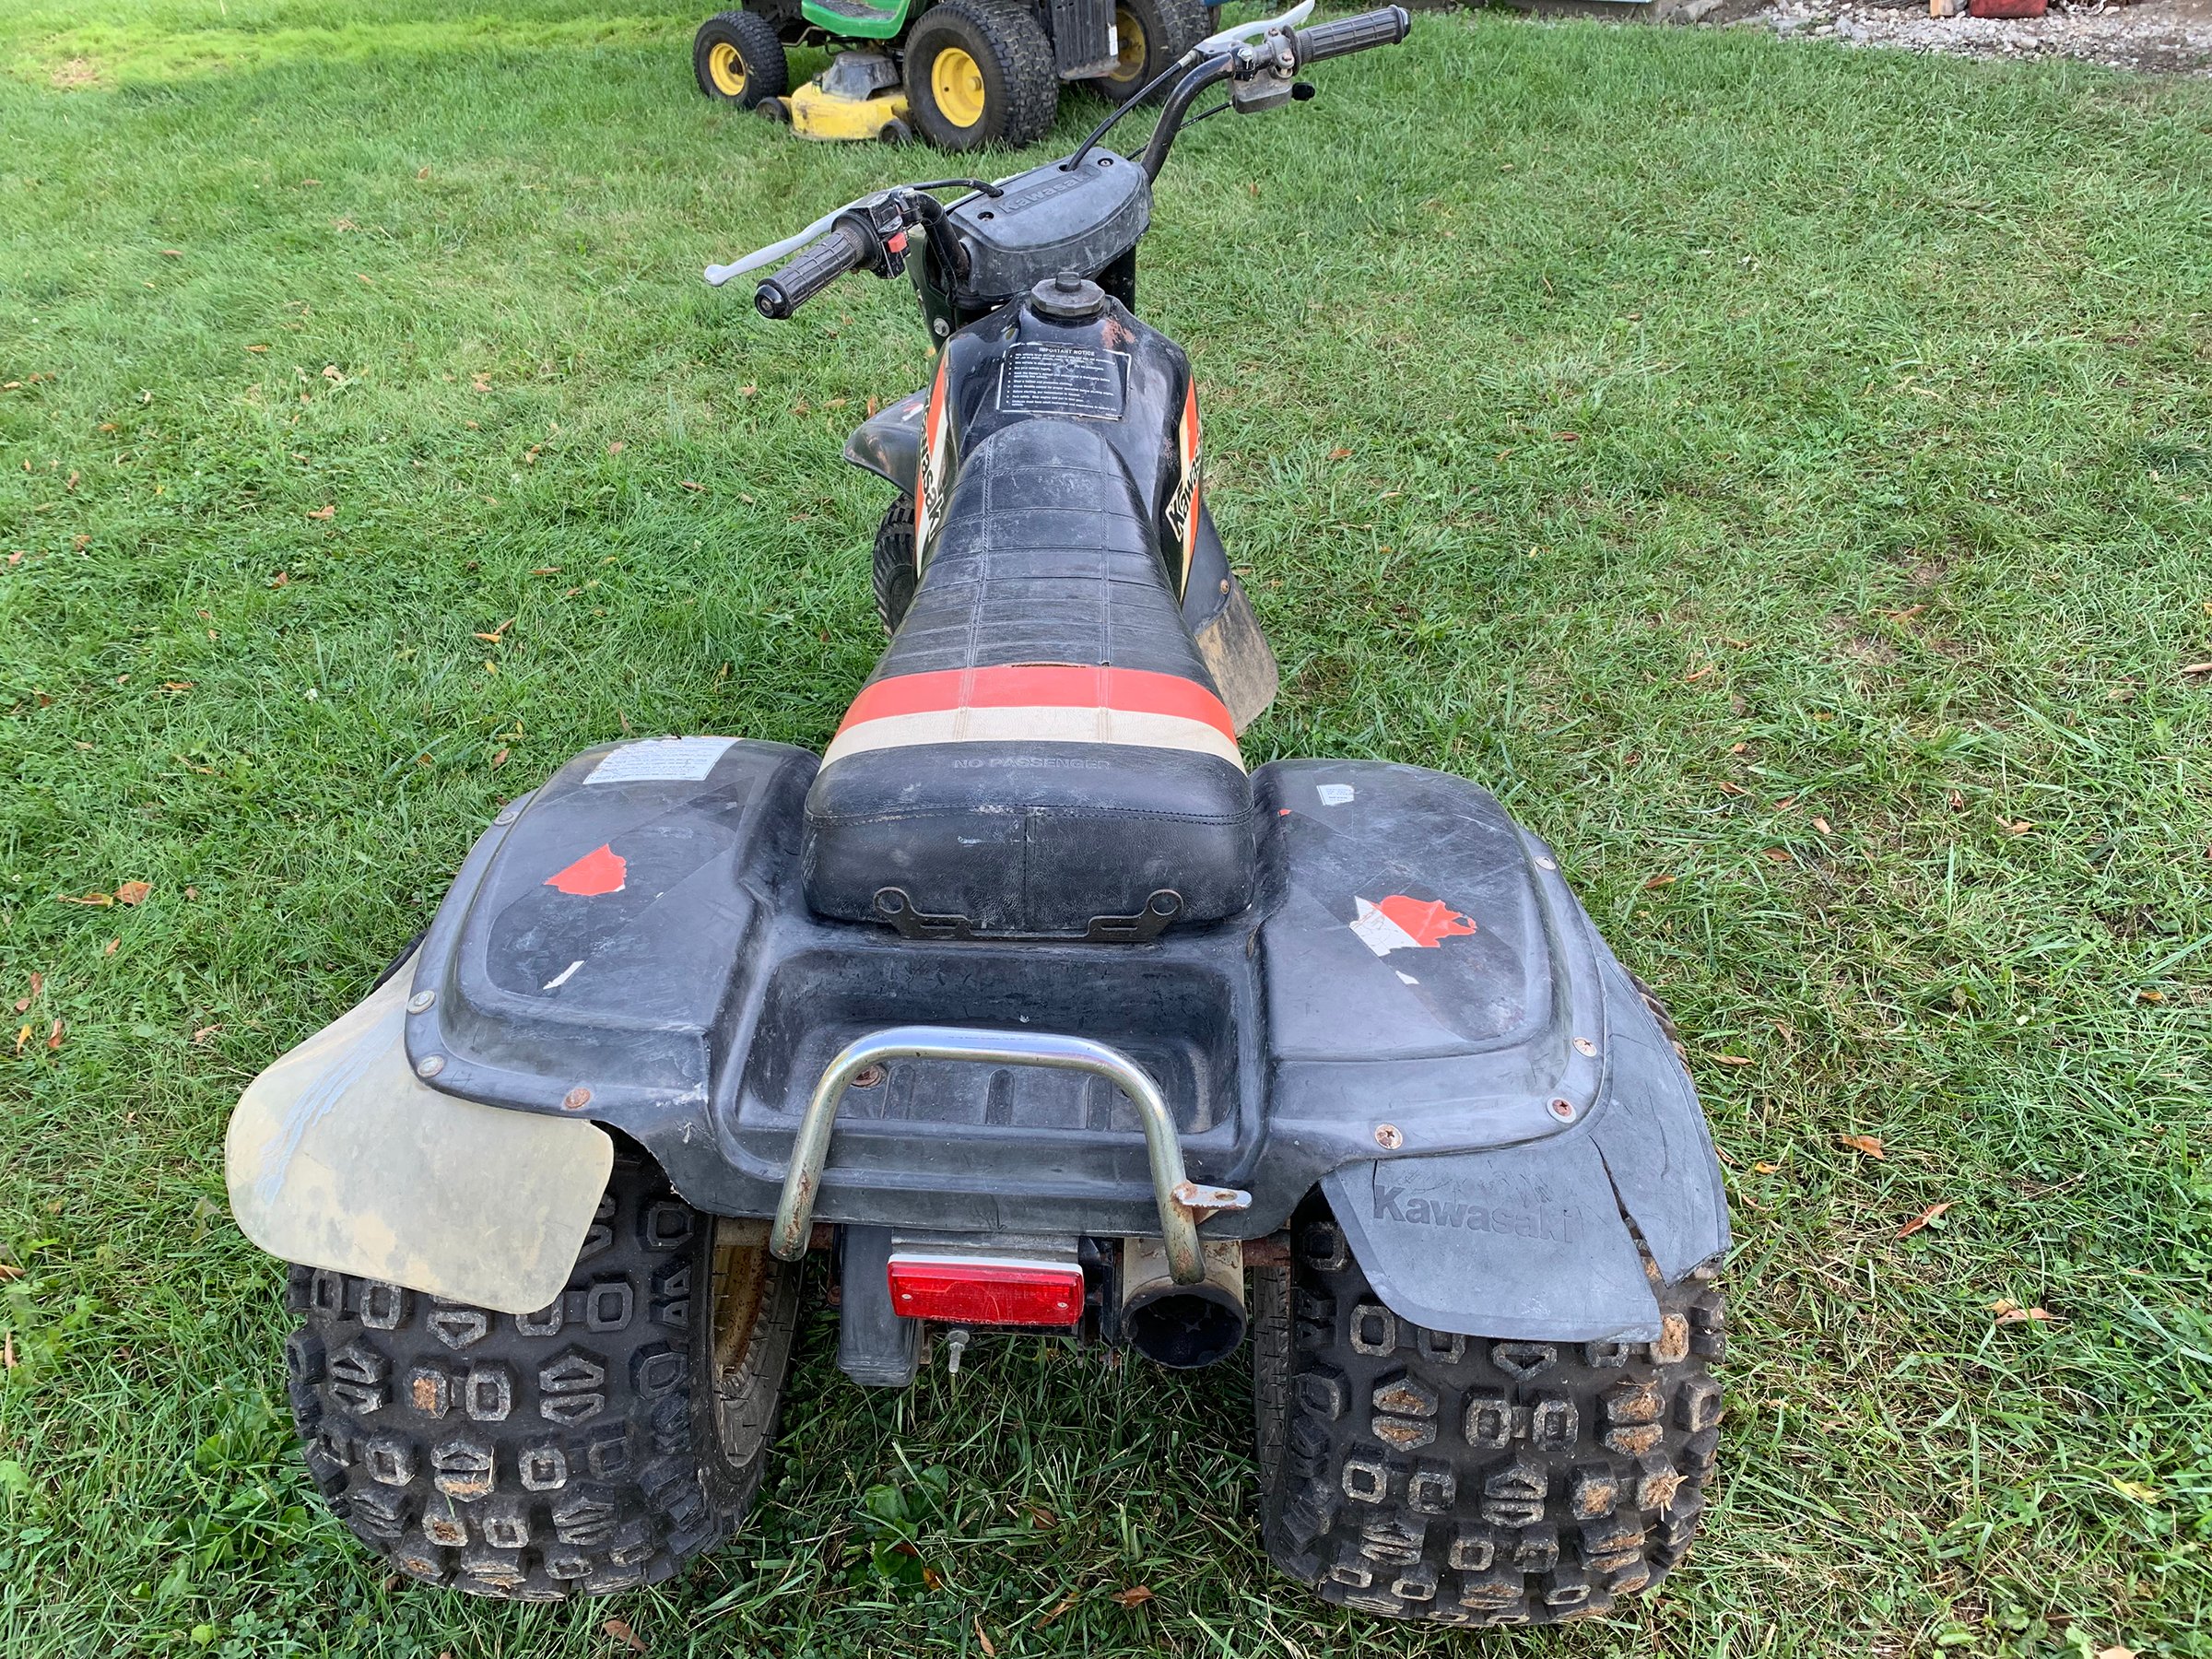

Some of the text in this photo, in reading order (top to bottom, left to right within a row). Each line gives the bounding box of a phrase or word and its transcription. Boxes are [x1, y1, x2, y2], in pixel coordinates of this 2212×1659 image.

[953, 758, 1112, 770] NO PASSENGER
[1373, 1184, 1573, 1244] Kawasaki
